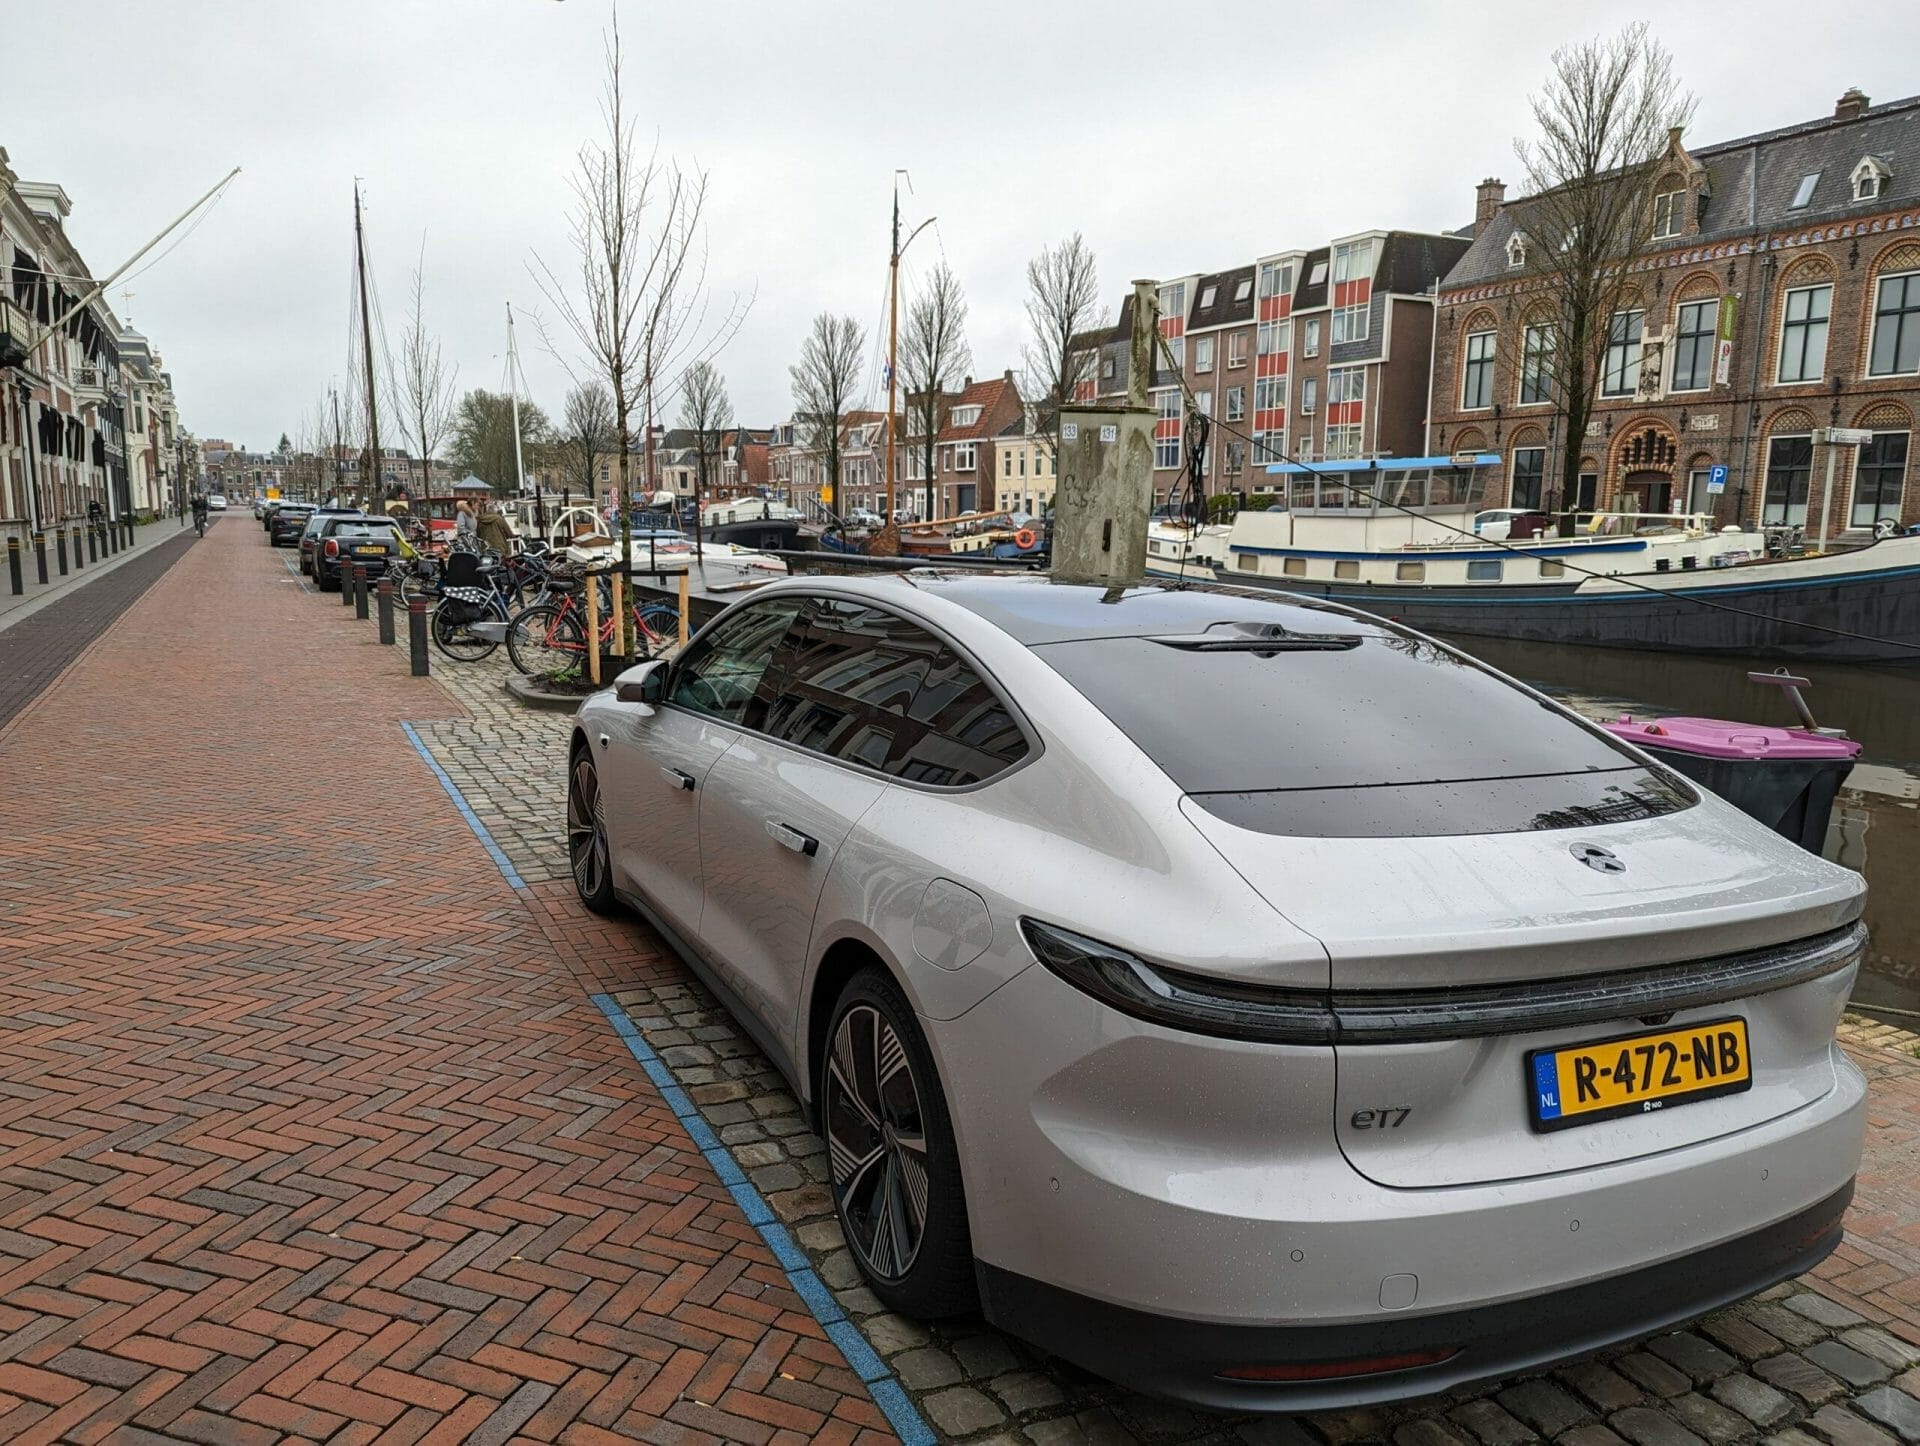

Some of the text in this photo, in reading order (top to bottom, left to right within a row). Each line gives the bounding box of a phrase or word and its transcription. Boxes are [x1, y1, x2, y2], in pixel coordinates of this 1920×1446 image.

[1063, 426, 1077, 437] 133
[1102, 428, 1115, 439] 131
[1712, 468, 1724, 481] P
[1574, 1031, 1740, 1103] R-472-NB
[1541, 1093, 1558, 1108] NL
